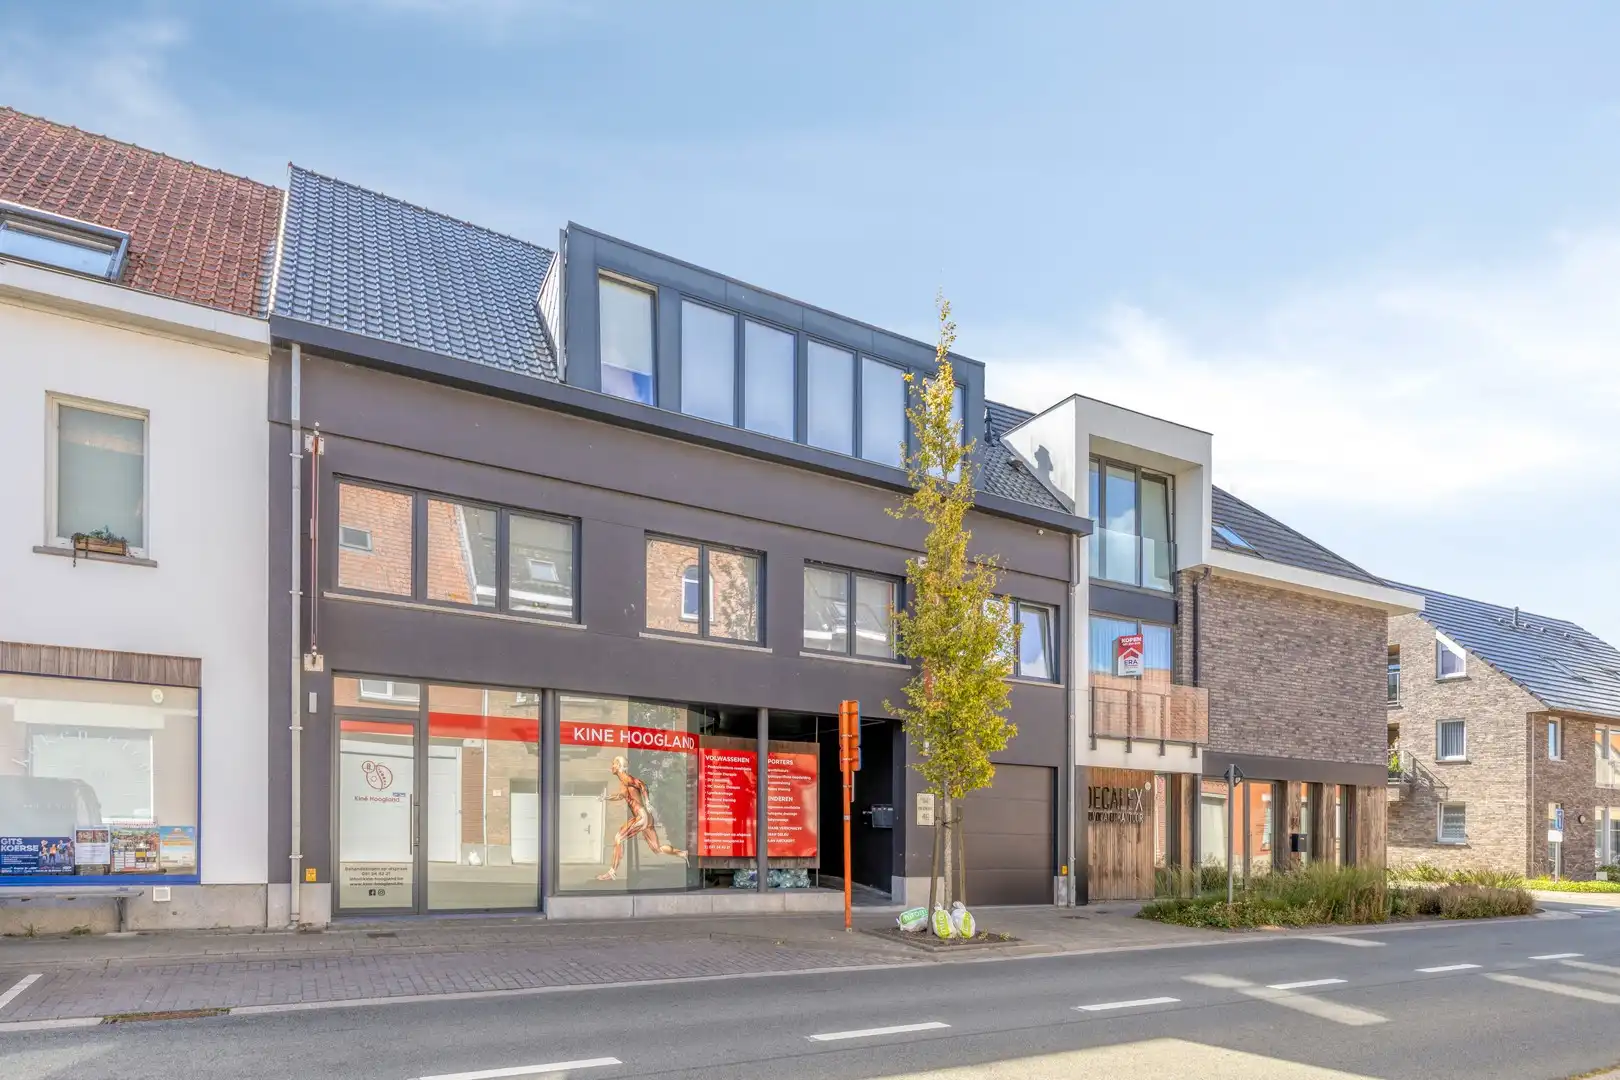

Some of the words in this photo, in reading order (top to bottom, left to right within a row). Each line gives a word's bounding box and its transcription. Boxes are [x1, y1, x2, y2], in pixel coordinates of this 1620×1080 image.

[573, 727, 614, 743] KINE
[620, 730, 695, 749] HOOGLAND
[705, 755, 750, 763] VOLWASSENEN
